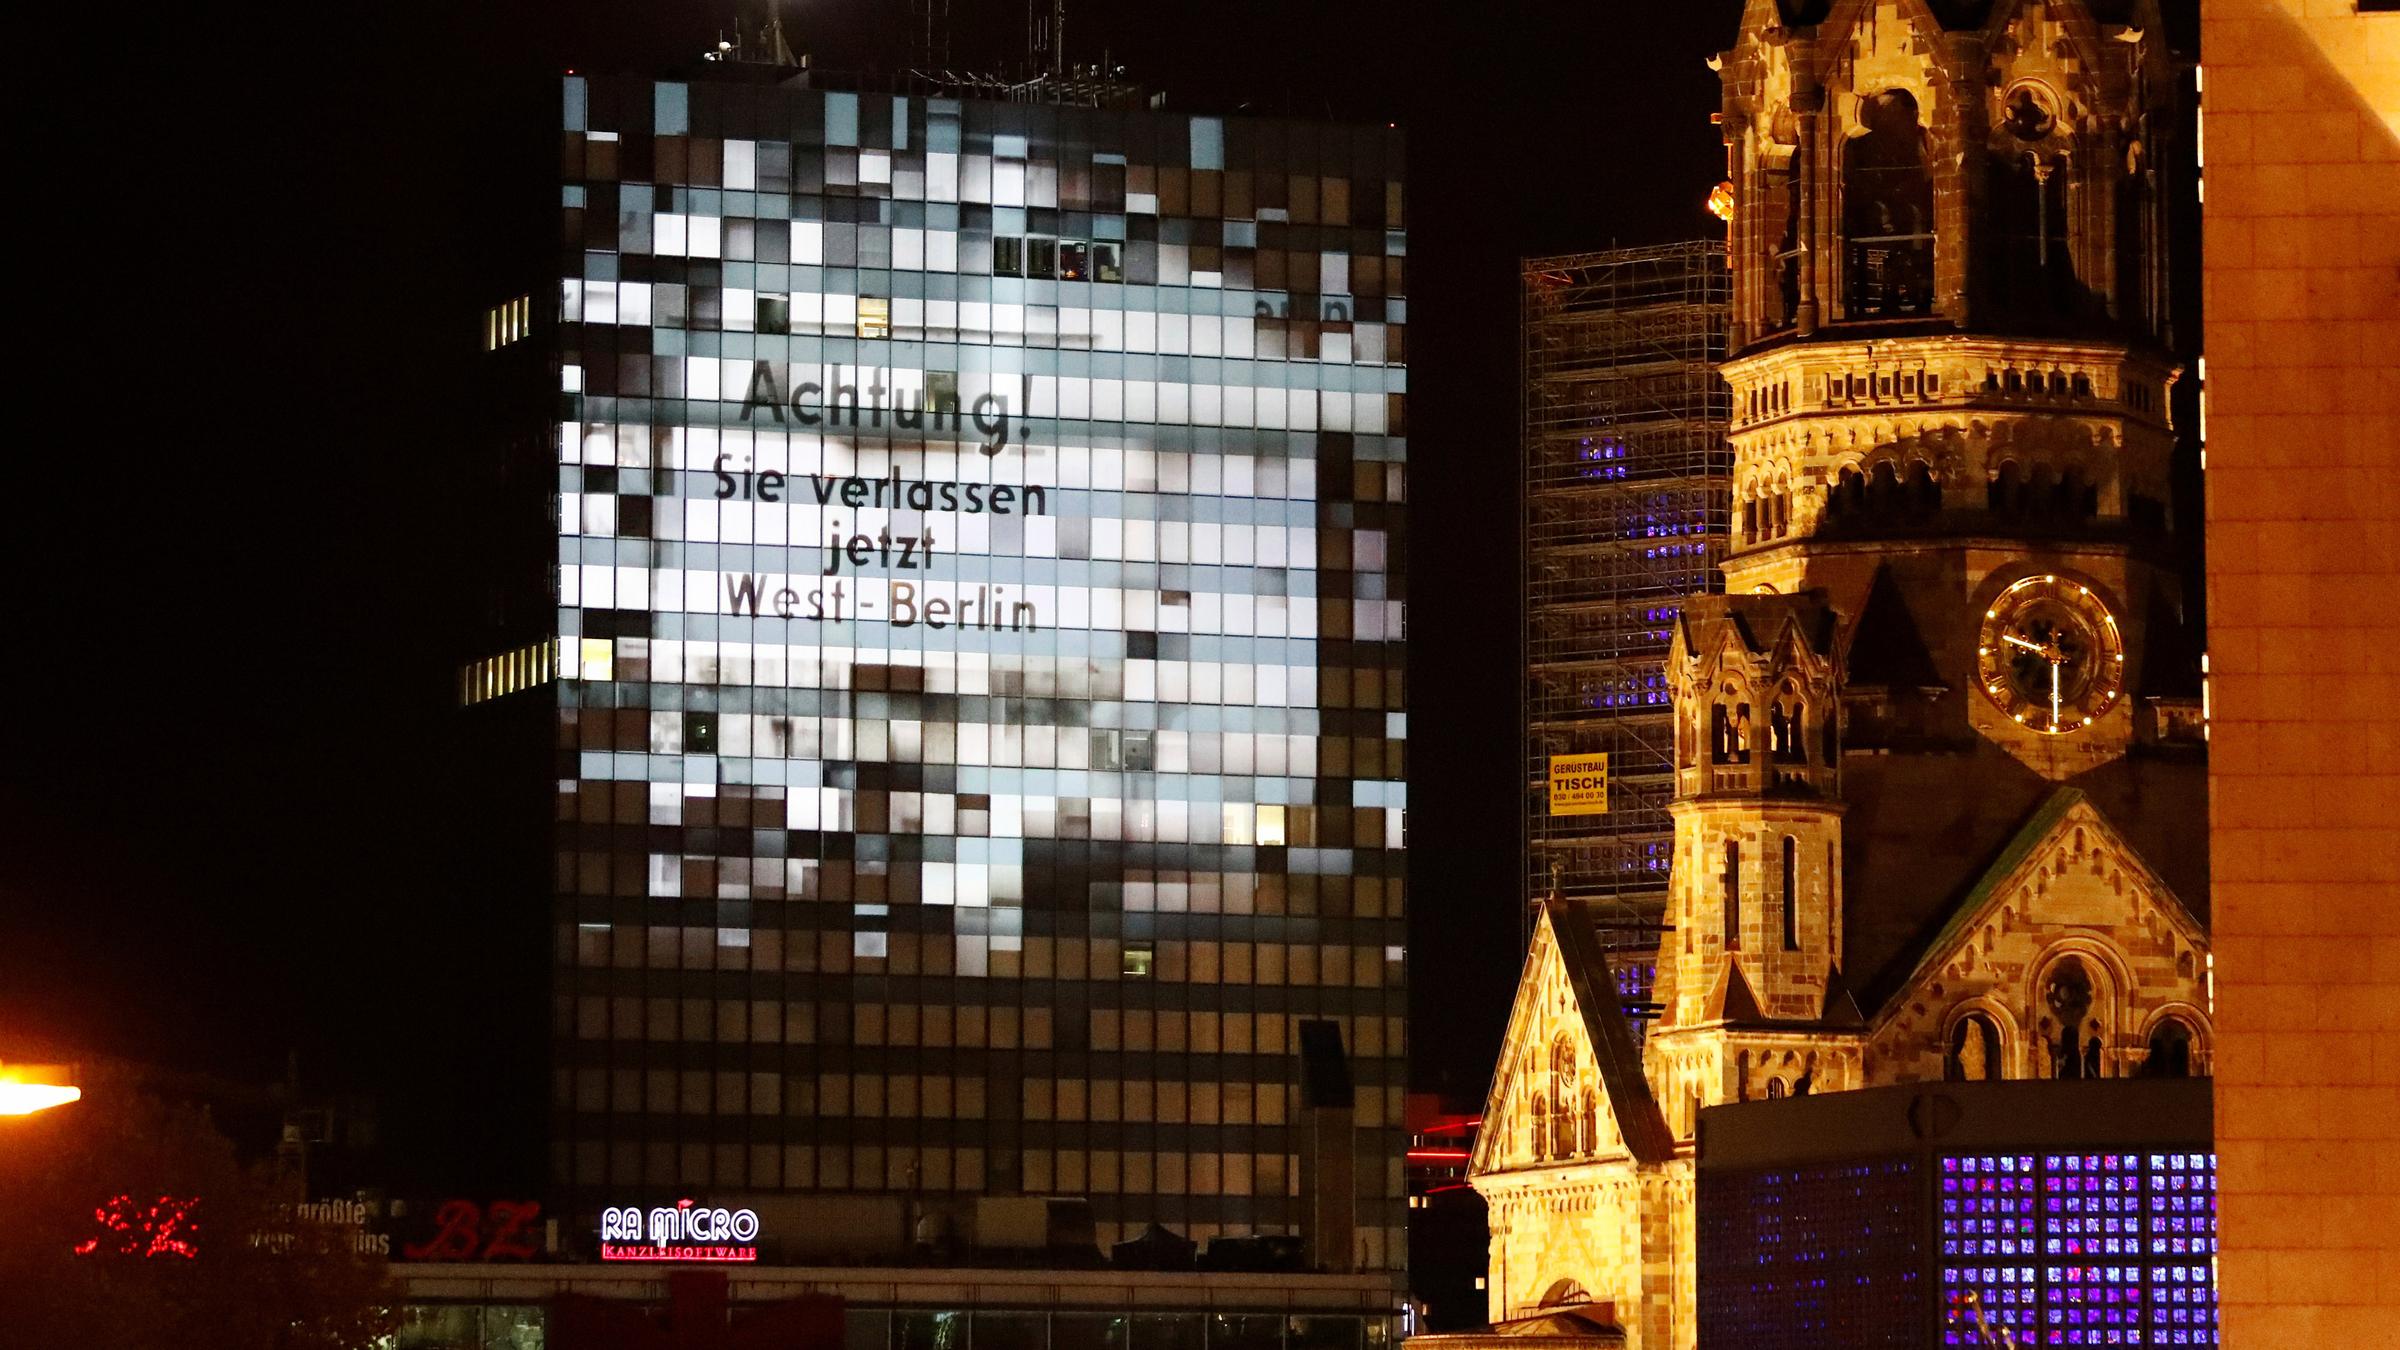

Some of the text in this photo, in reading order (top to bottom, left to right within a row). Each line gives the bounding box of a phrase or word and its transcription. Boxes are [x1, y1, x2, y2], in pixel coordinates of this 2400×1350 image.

[739, 359, 1033, 457] Achtung!
[714, 453, 1046, 516] Sie verlassen
[824, 519, 935, 576] jetzt
[1554, 777, 1604, 790] TISCH
[602, 1207, 760, 1243] RA MICRO
[604, 1246, 757, 1258] KANZLEISOFTWARE
